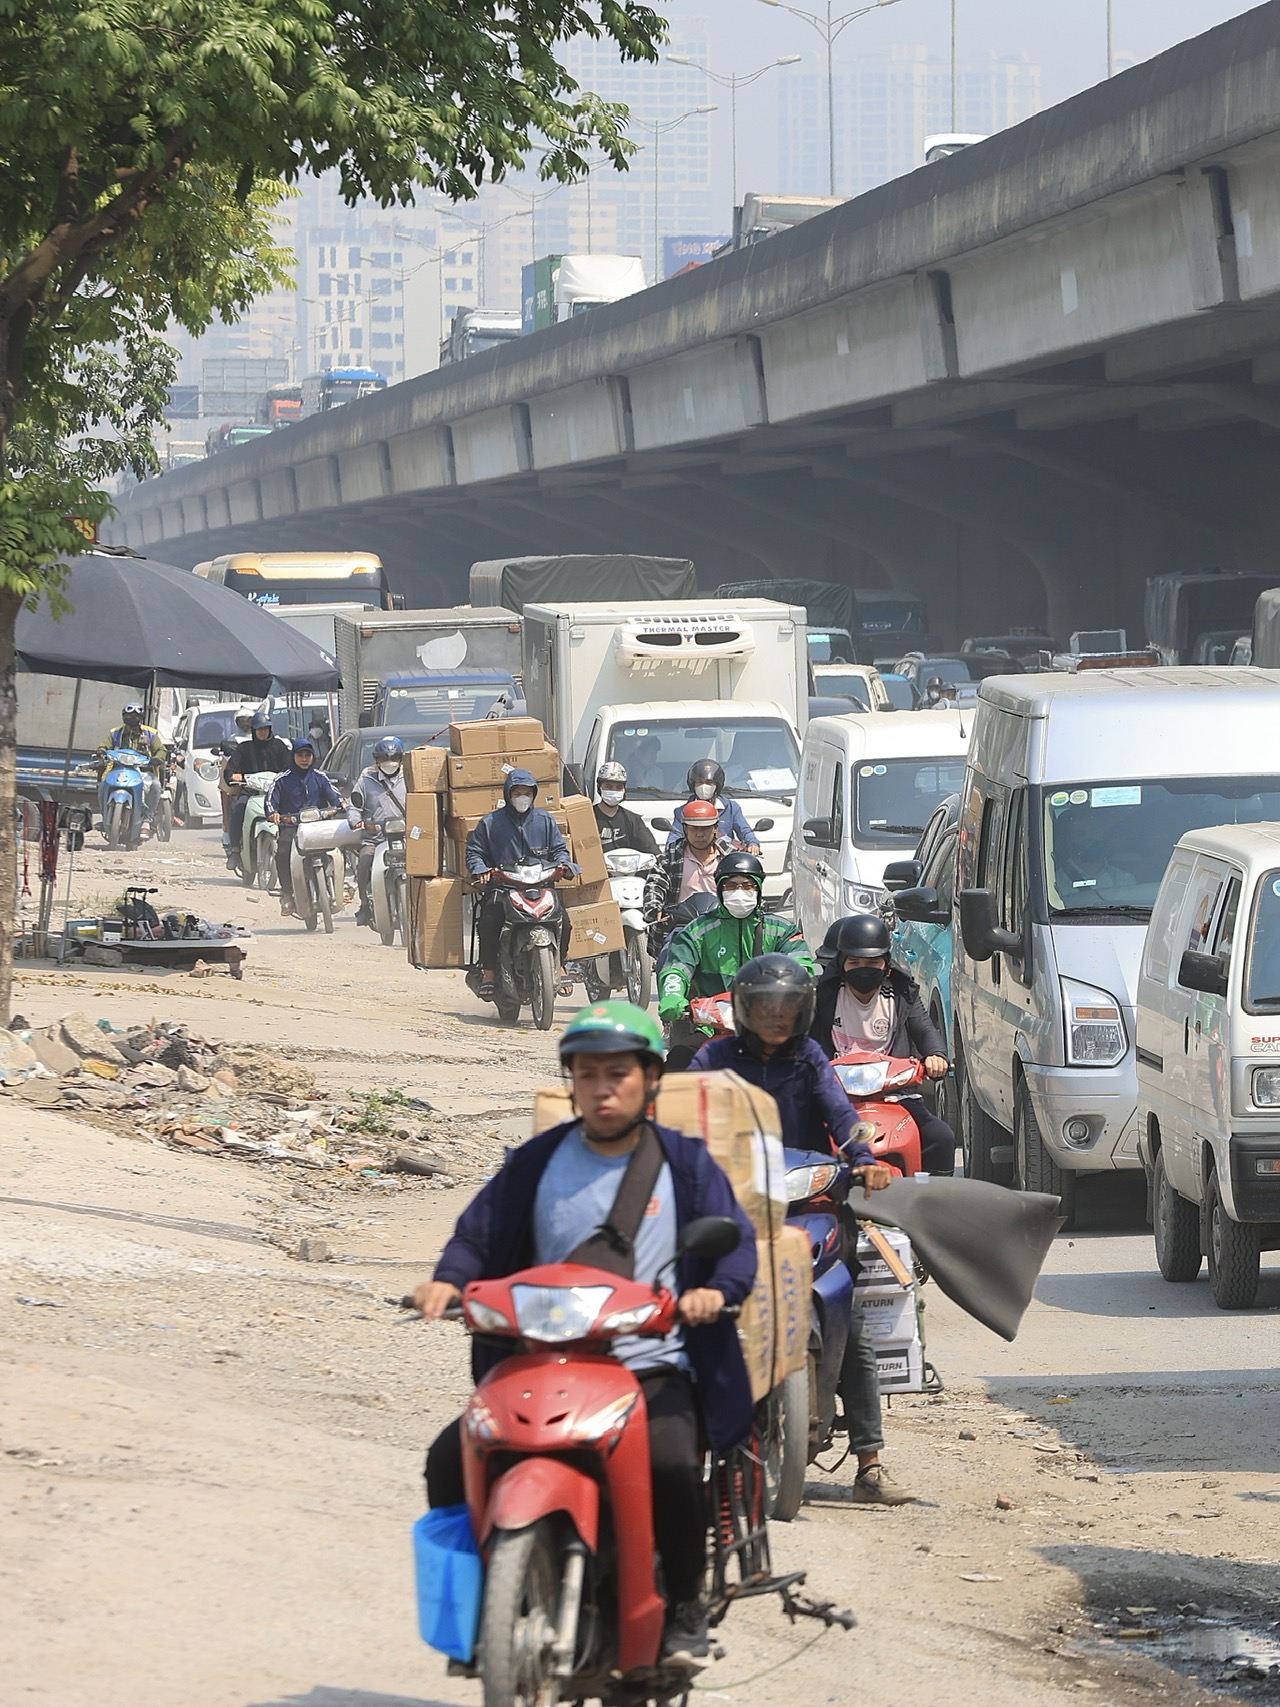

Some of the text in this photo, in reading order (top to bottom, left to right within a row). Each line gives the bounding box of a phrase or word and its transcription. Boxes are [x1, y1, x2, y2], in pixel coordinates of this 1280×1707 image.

[692, 625, 731, 633] MASTER
[861, 1264, 890, 1274] ATUR
[861, 1298, 894, 1309] ATURN
[876, 1362, 902, 1371] TURN
